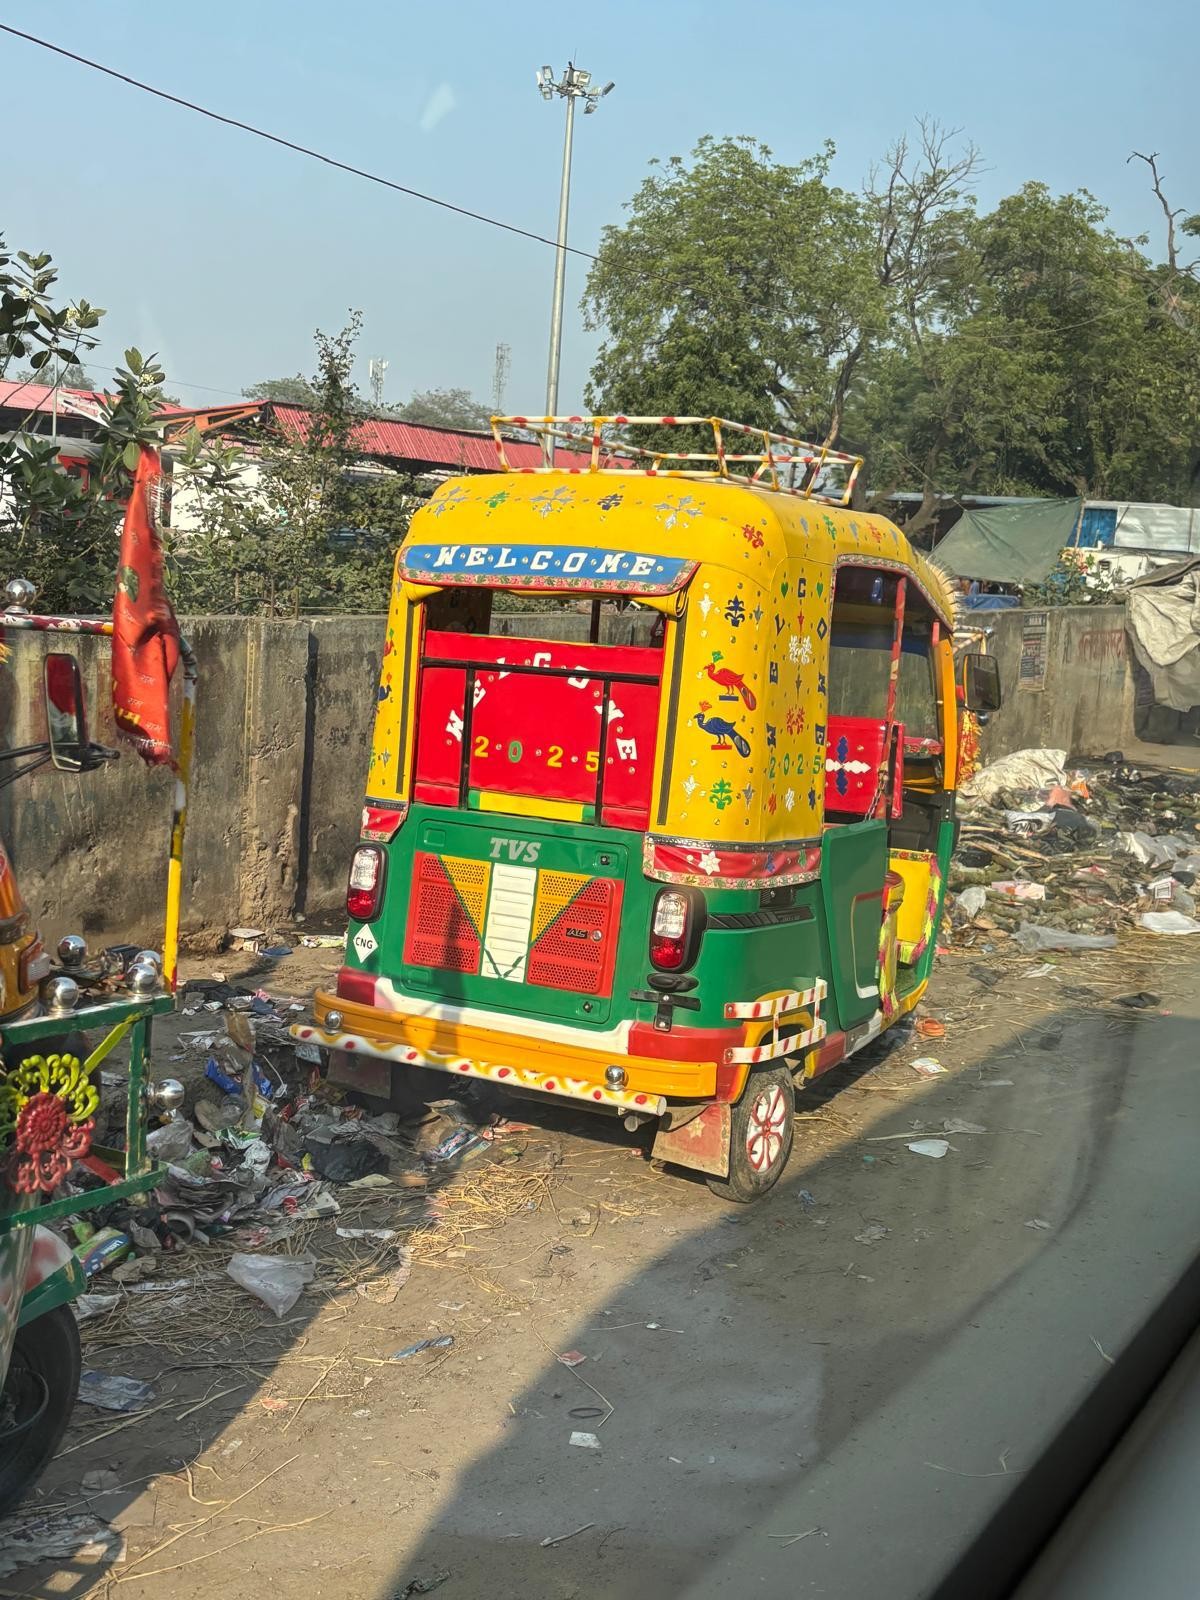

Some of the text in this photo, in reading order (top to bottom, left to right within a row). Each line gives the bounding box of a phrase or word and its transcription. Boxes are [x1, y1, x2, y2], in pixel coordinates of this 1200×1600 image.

[433, 545, 657, 576] WELCOME
[769, 752, 822, 779] 2025
[489, 837, 542, 863] TVS
[355, 936, 374, 950] CNG
